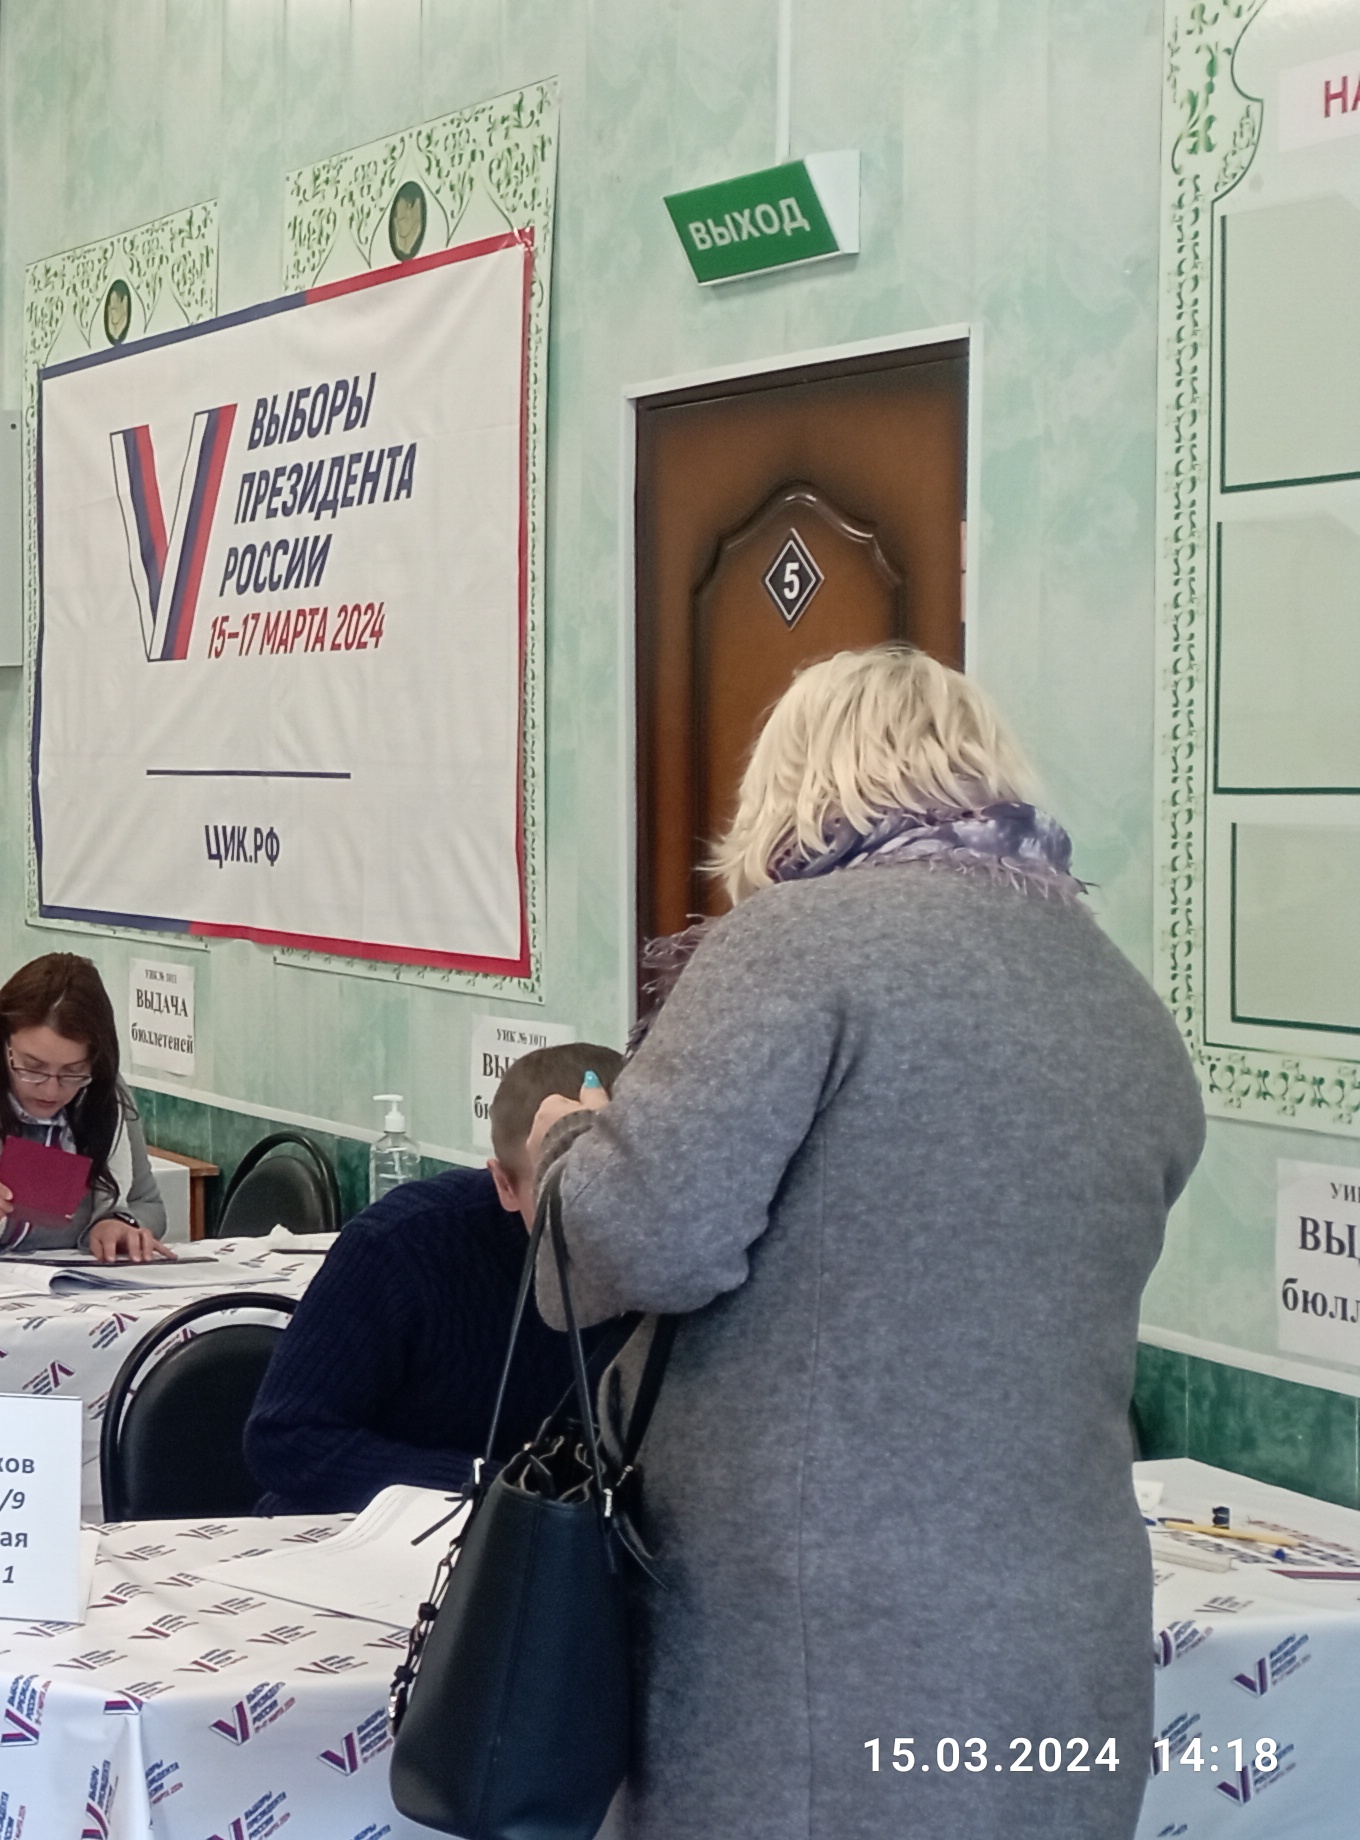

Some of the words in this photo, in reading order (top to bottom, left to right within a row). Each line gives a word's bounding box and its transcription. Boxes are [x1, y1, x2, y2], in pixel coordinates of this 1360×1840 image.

[688, 197, 811, 251] ВЫХОД
[247, 371, 377, 451] ВЫБОРЫ
[234, 442, 418, 525] ПРЕЗИДЕНТА
[219, 533, 333, 598] РОССИИ
[783, 562, 800, 600] 5
[259, 606, 329, 656] МАРТА
[330, 601, 386, 651] 2024
[204, 824, 280, 869] ЦИК.РФ
[136, 988, 188, 1017] ВЫДАЧА
[131, 1022, 194, 1054] бюллетеней
[1330, 1182, 1360, 1204] УИ
